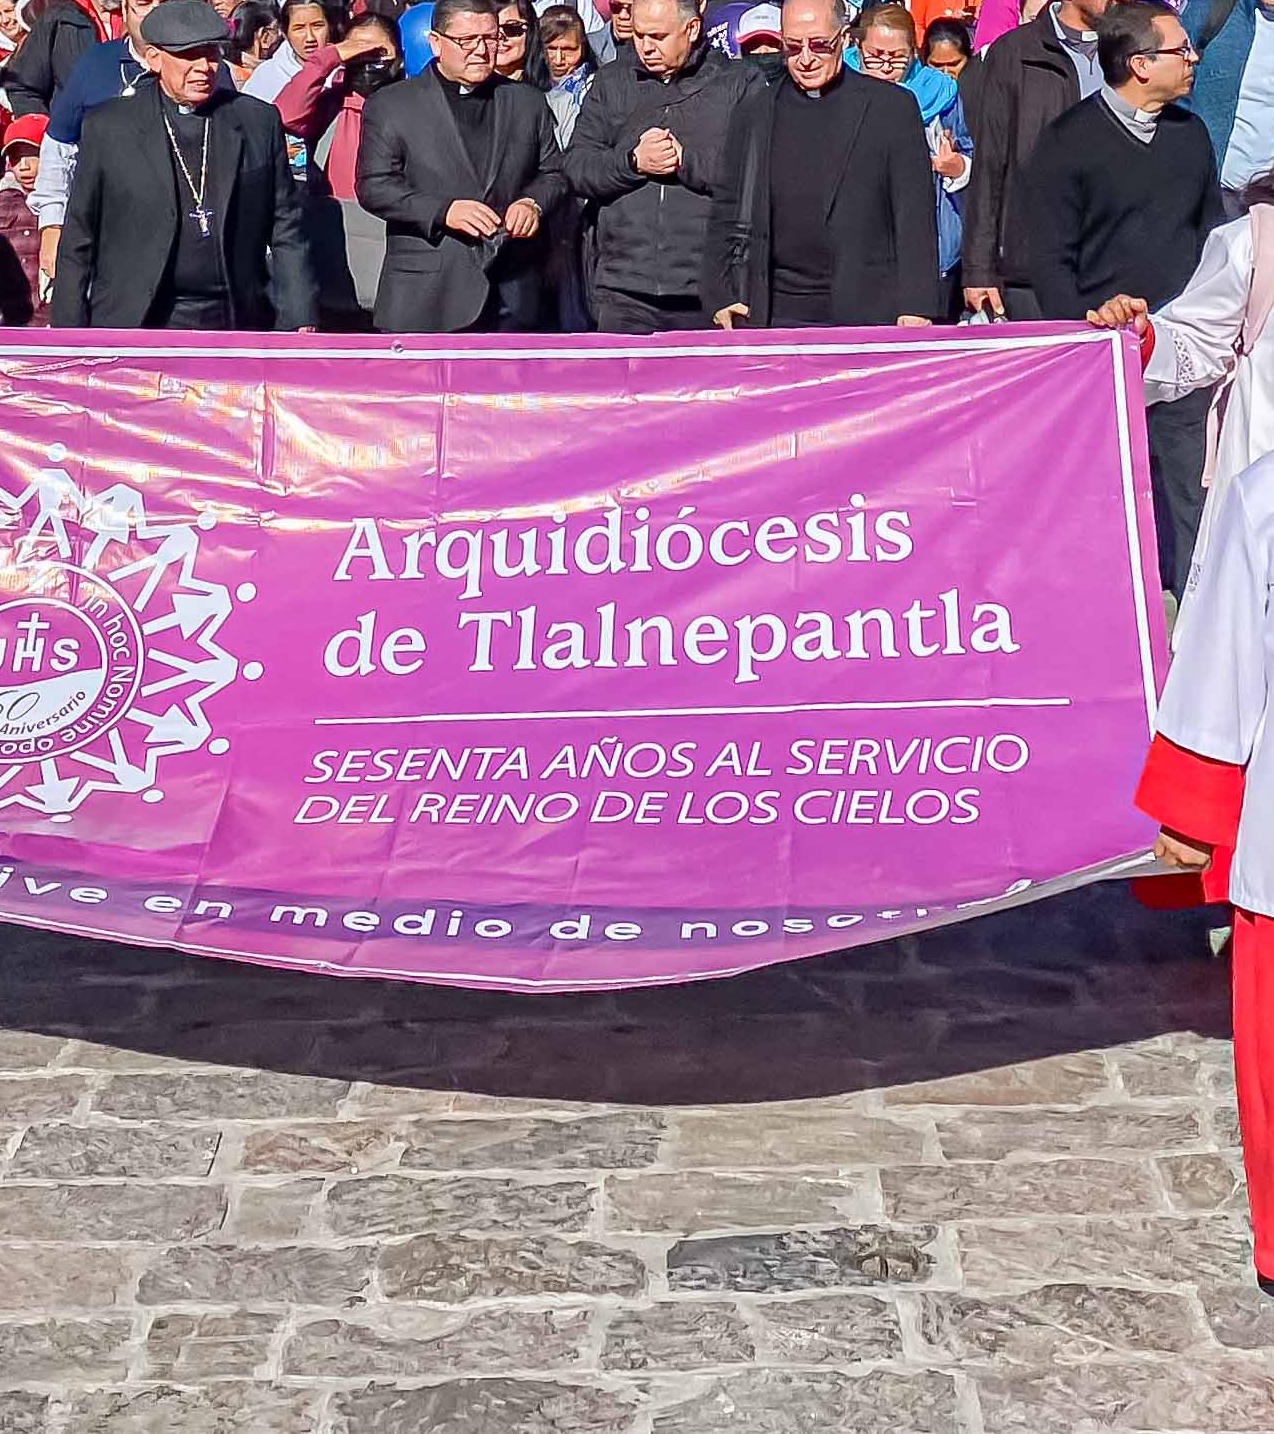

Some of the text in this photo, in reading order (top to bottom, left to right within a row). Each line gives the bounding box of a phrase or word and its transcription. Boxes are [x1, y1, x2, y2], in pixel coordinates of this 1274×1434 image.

[332, 493, 914, 600] Arquidiócesis
[323, 587, 1021, 684] de Tlalnepantla
[59, 665, 136, 743] Nomine
[303, 732, 1031, 784] SESENTA AÑOS AL SERVICIO
[293, 788, 982, 825] DEL REINO DE LOS CIELOS
[143, 894, 233, 918] en
[269, 903, 514, 939] medio
[548, 914, 642, 941] de
